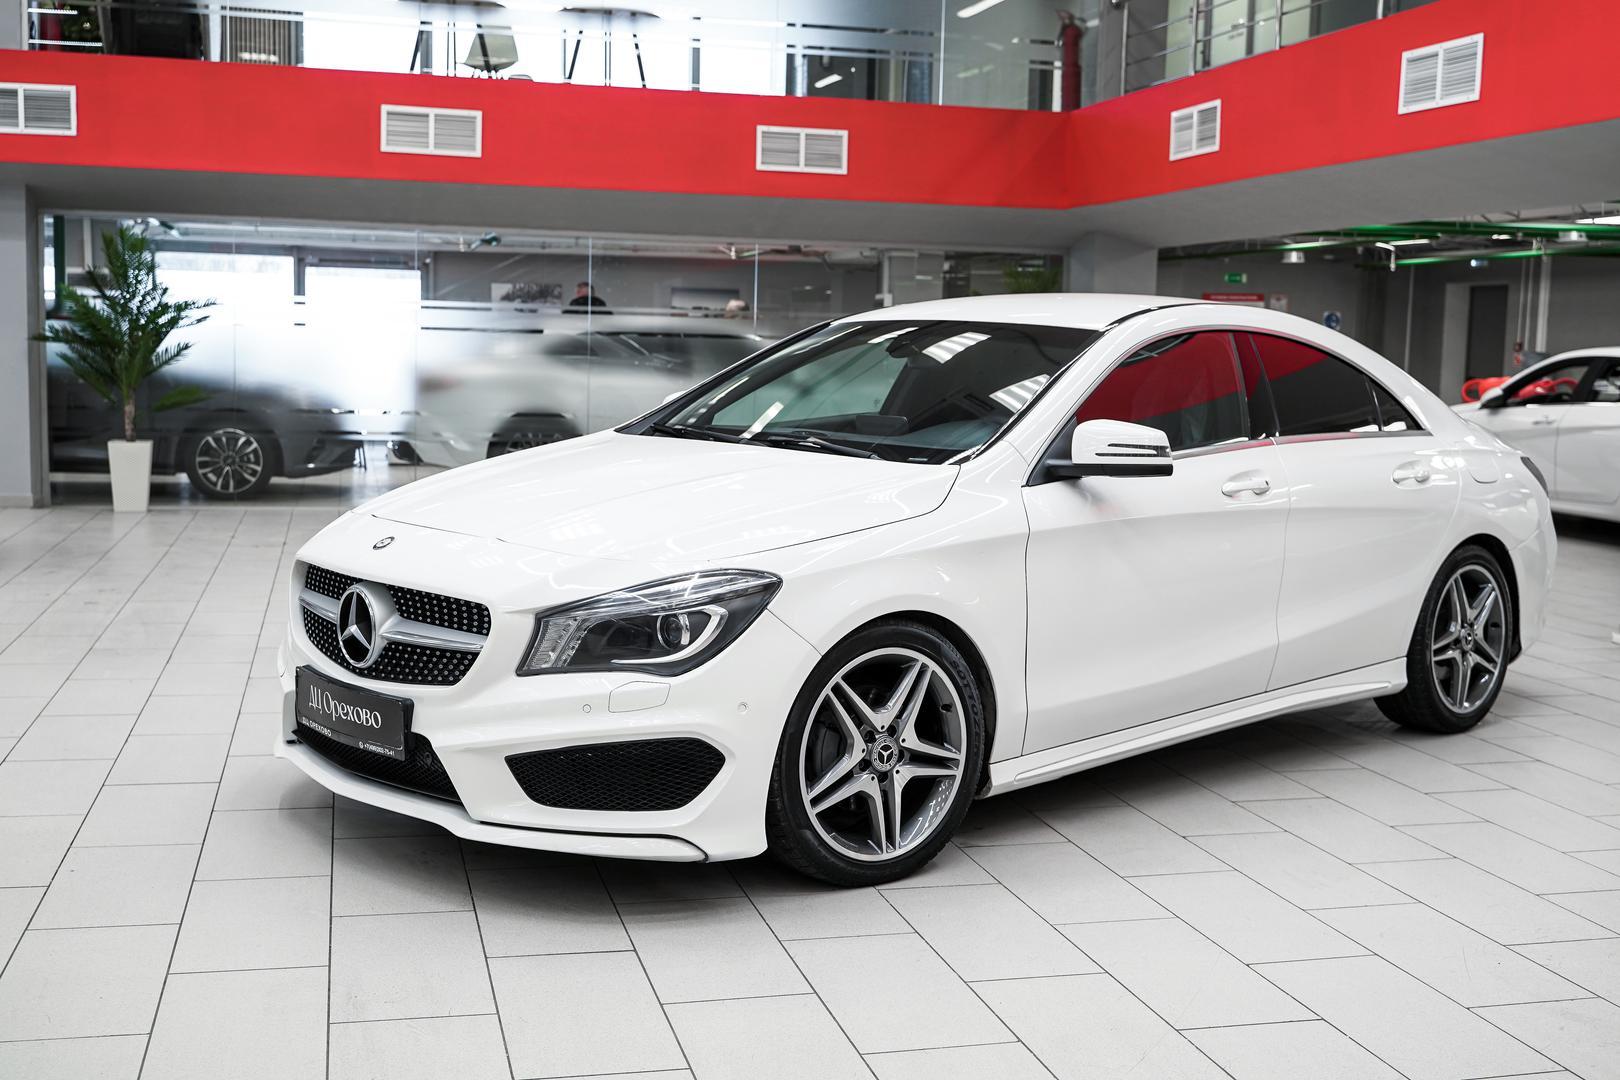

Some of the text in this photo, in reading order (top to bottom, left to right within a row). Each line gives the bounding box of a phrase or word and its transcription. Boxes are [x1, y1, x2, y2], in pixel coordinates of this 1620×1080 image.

[309, 685, 382, 729] ДЦ Орехово
[310, 720, 332, 737] ОРЕХОВО
